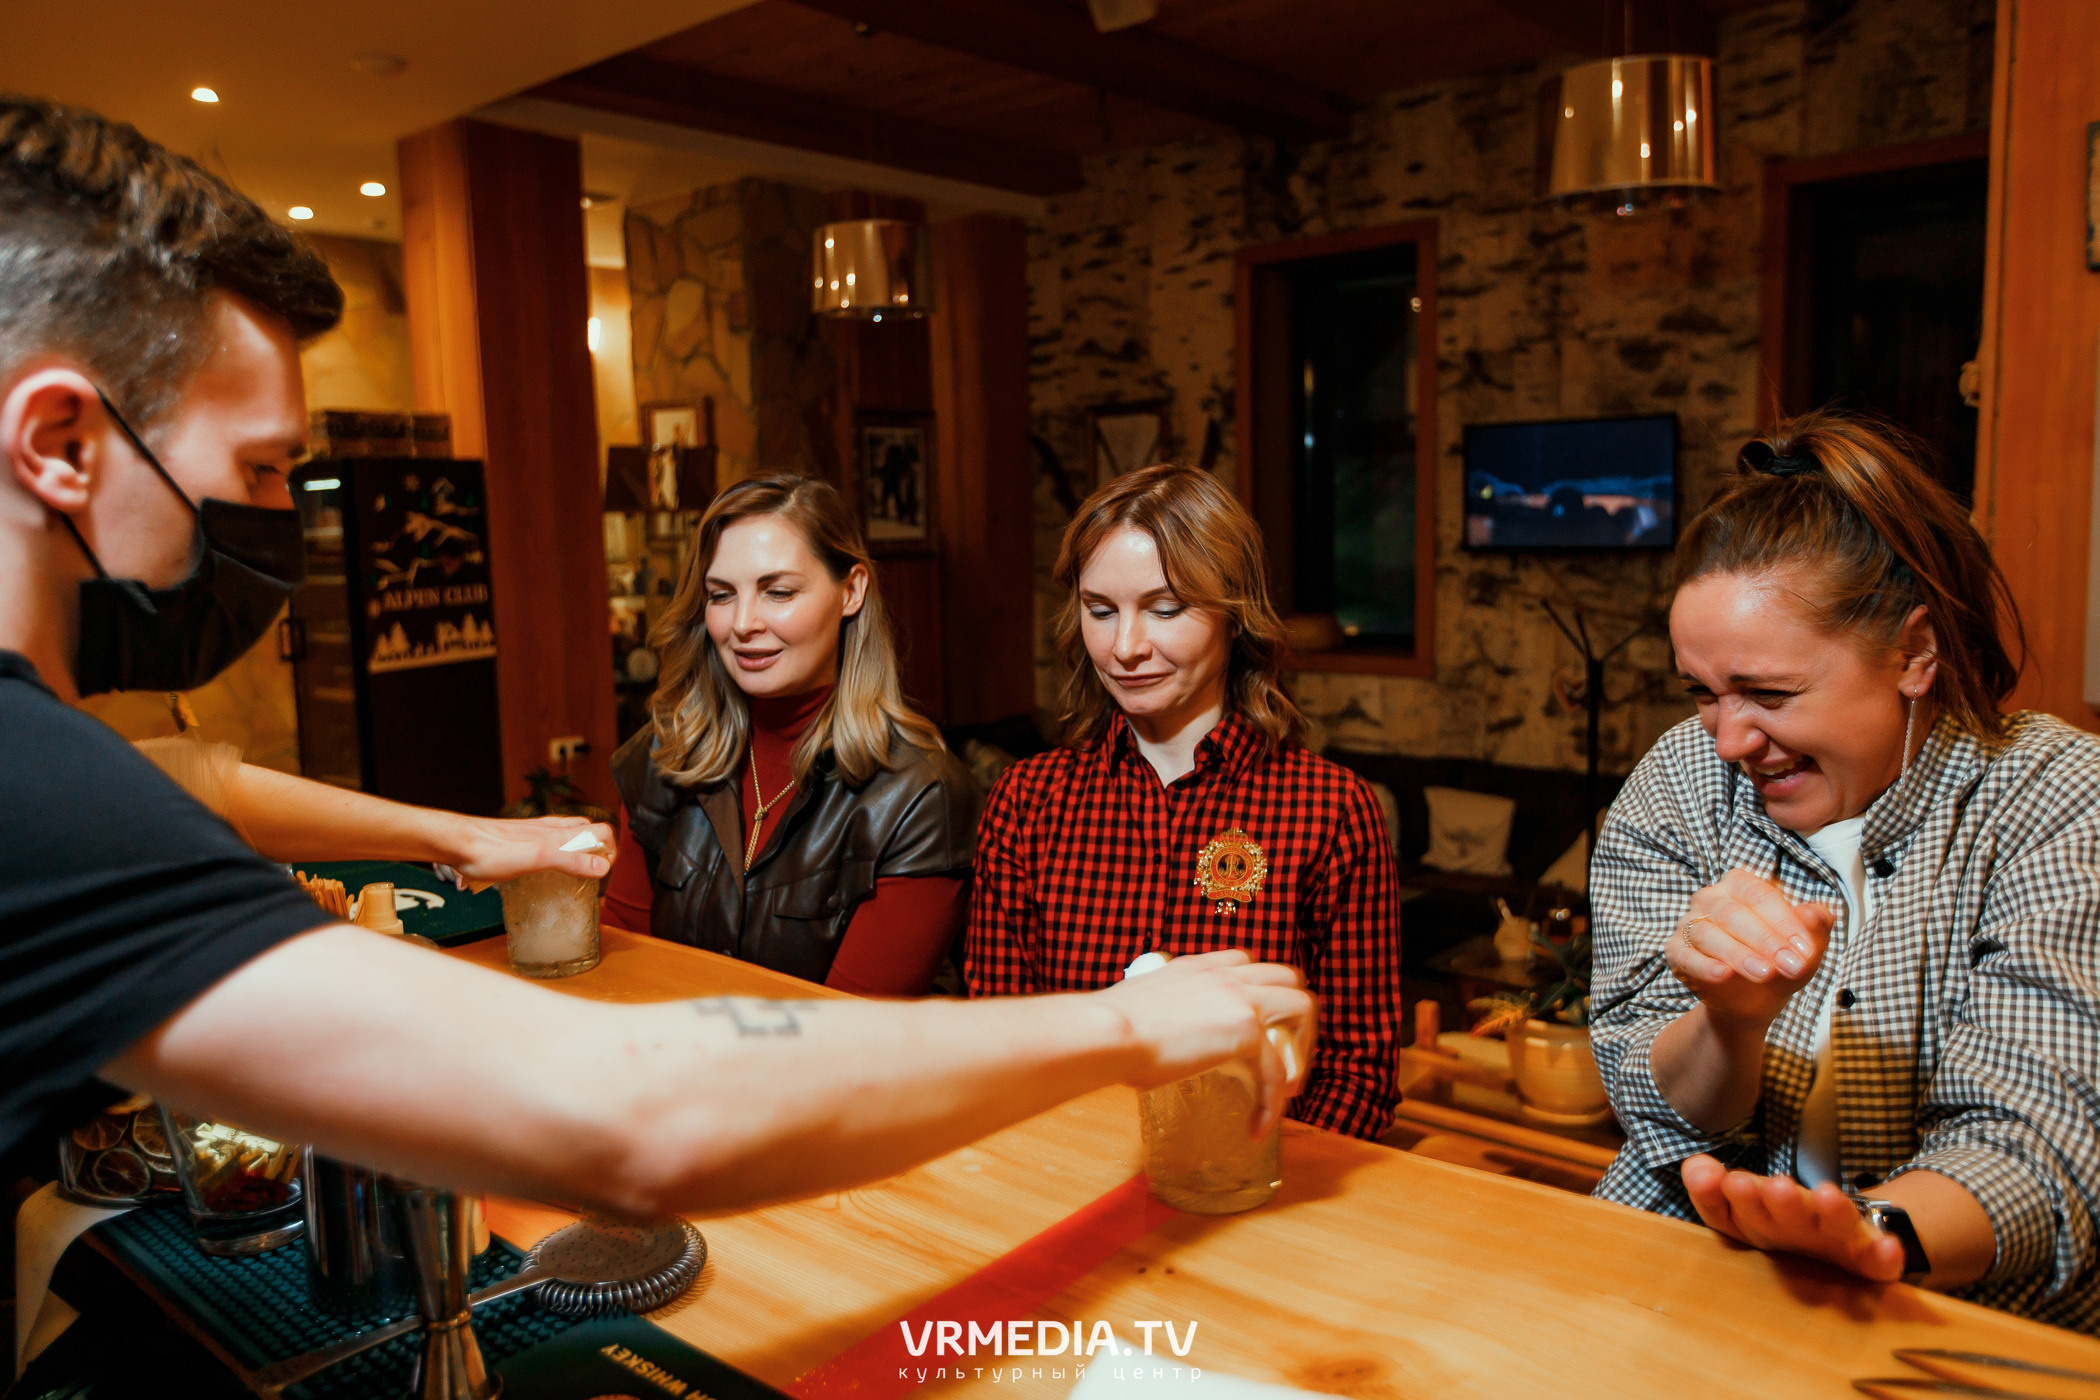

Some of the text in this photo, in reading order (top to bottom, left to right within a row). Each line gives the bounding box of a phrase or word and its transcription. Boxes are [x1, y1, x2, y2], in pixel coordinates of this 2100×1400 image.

[383, 583, 488, 612] ALPEN CLUB
[600, 1342, 688, 1397] WHISKEY
